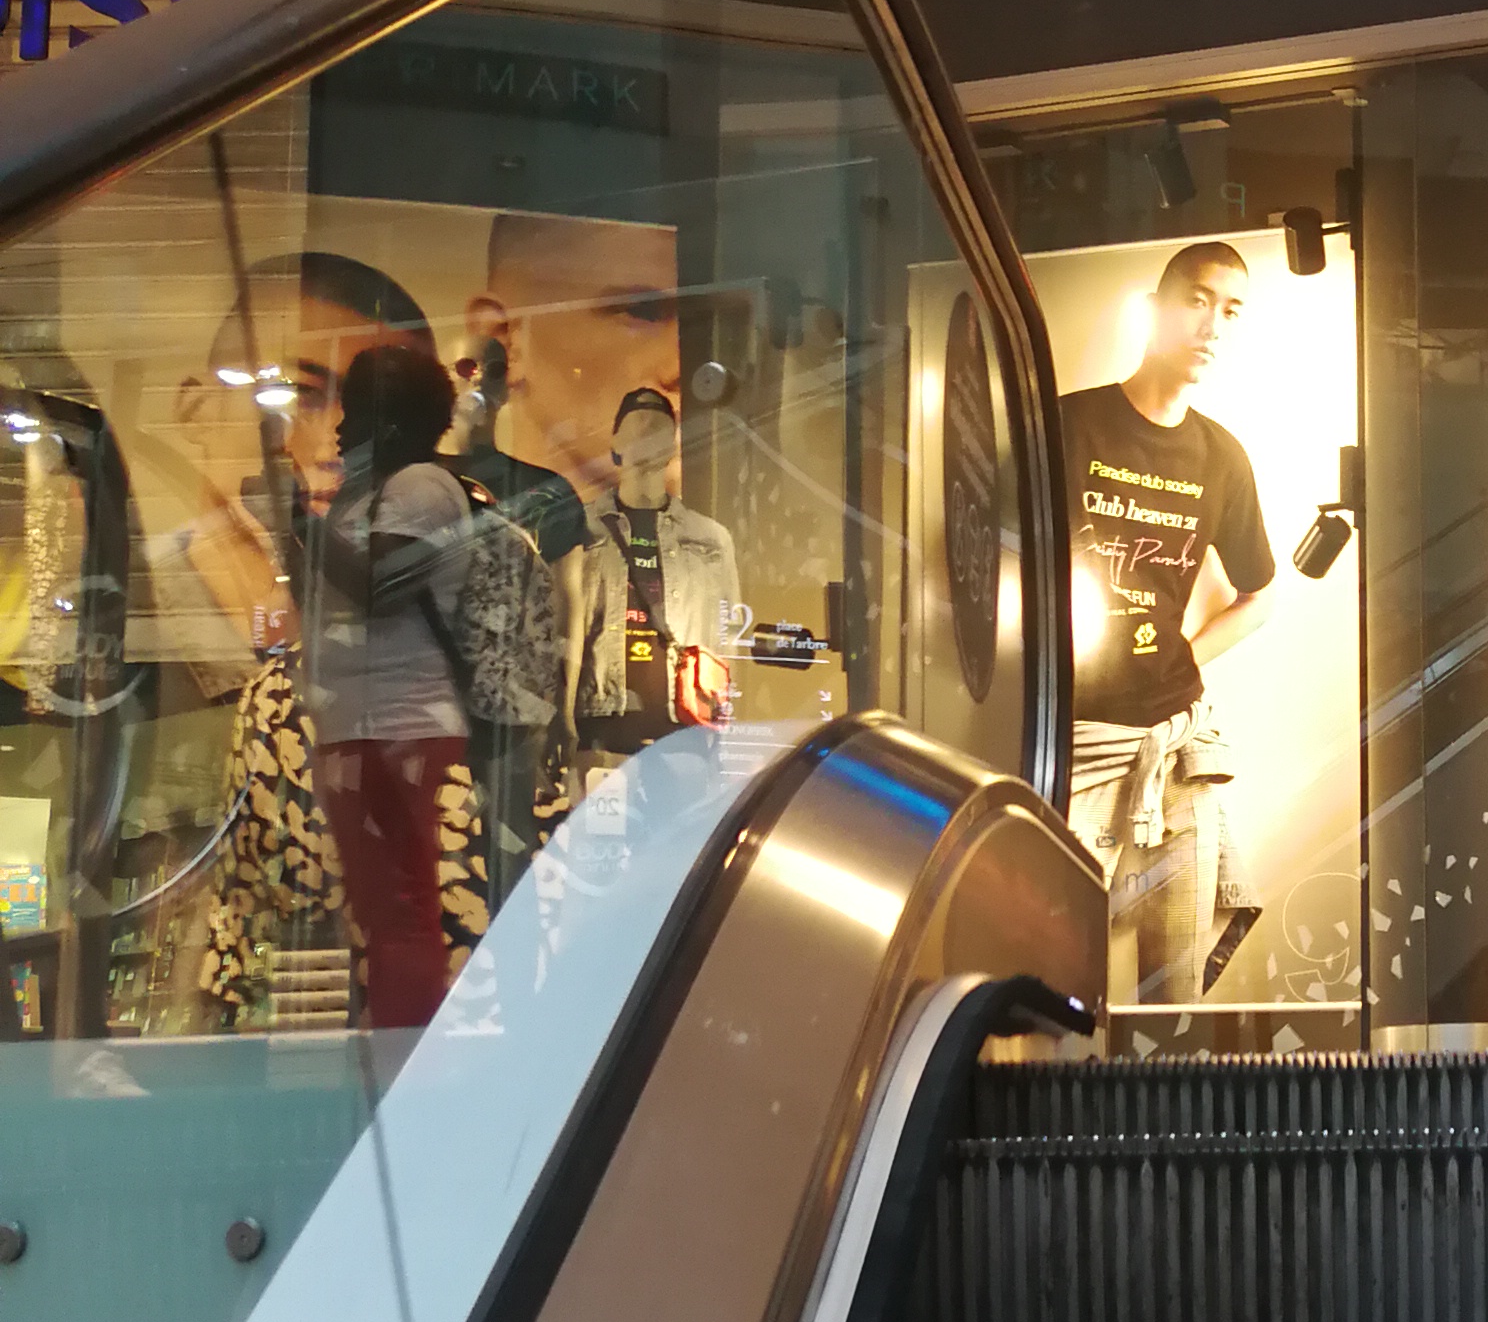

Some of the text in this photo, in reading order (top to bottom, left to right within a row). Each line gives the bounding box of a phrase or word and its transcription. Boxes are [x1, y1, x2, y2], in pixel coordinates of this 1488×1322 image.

[1089, 460, 1204, 499] Paradise club society
[1083, 491, 1124, 518] Club
[1125, 498, 1183, 528] heaven
[730, 603, 756, 647] 2
